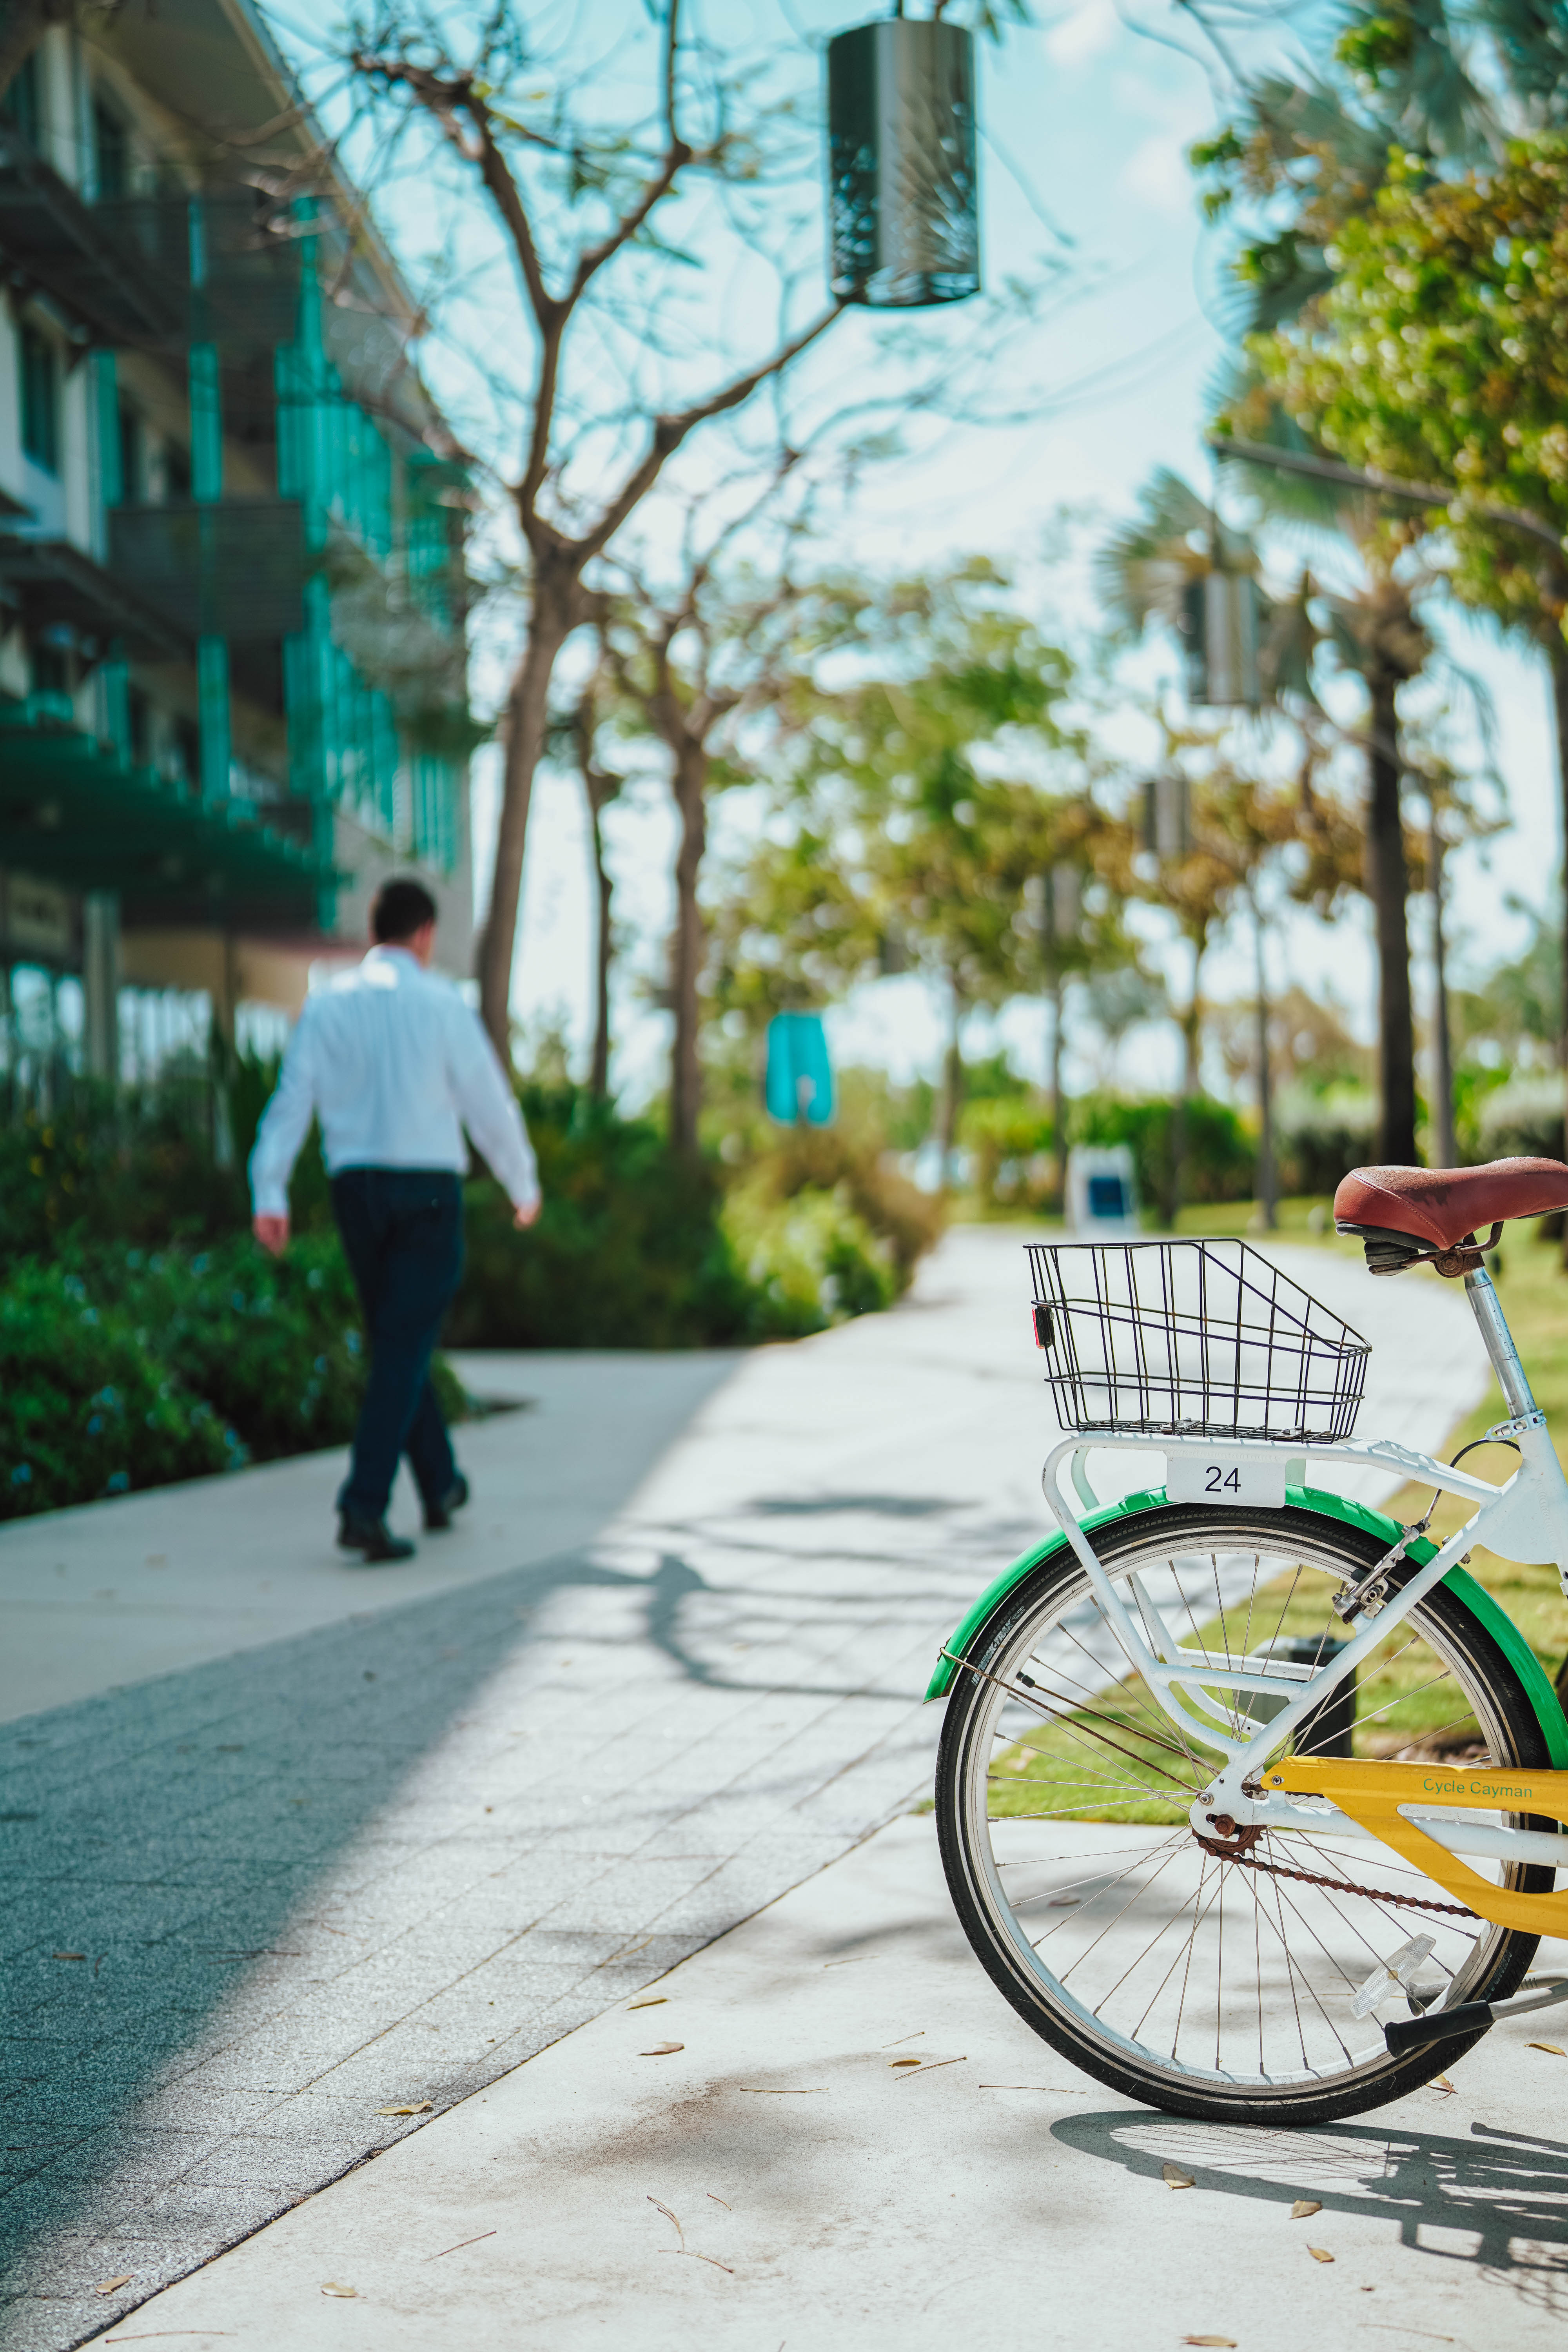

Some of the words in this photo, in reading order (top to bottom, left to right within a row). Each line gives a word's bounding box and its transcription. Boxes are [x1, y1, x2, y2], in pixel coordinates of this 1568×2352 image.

[1205, 1466, 1241, 1493] 24
[1424, 1778, 1465, 1795] Cycle
[1470, 1782, 1532, 1798] Cayman
